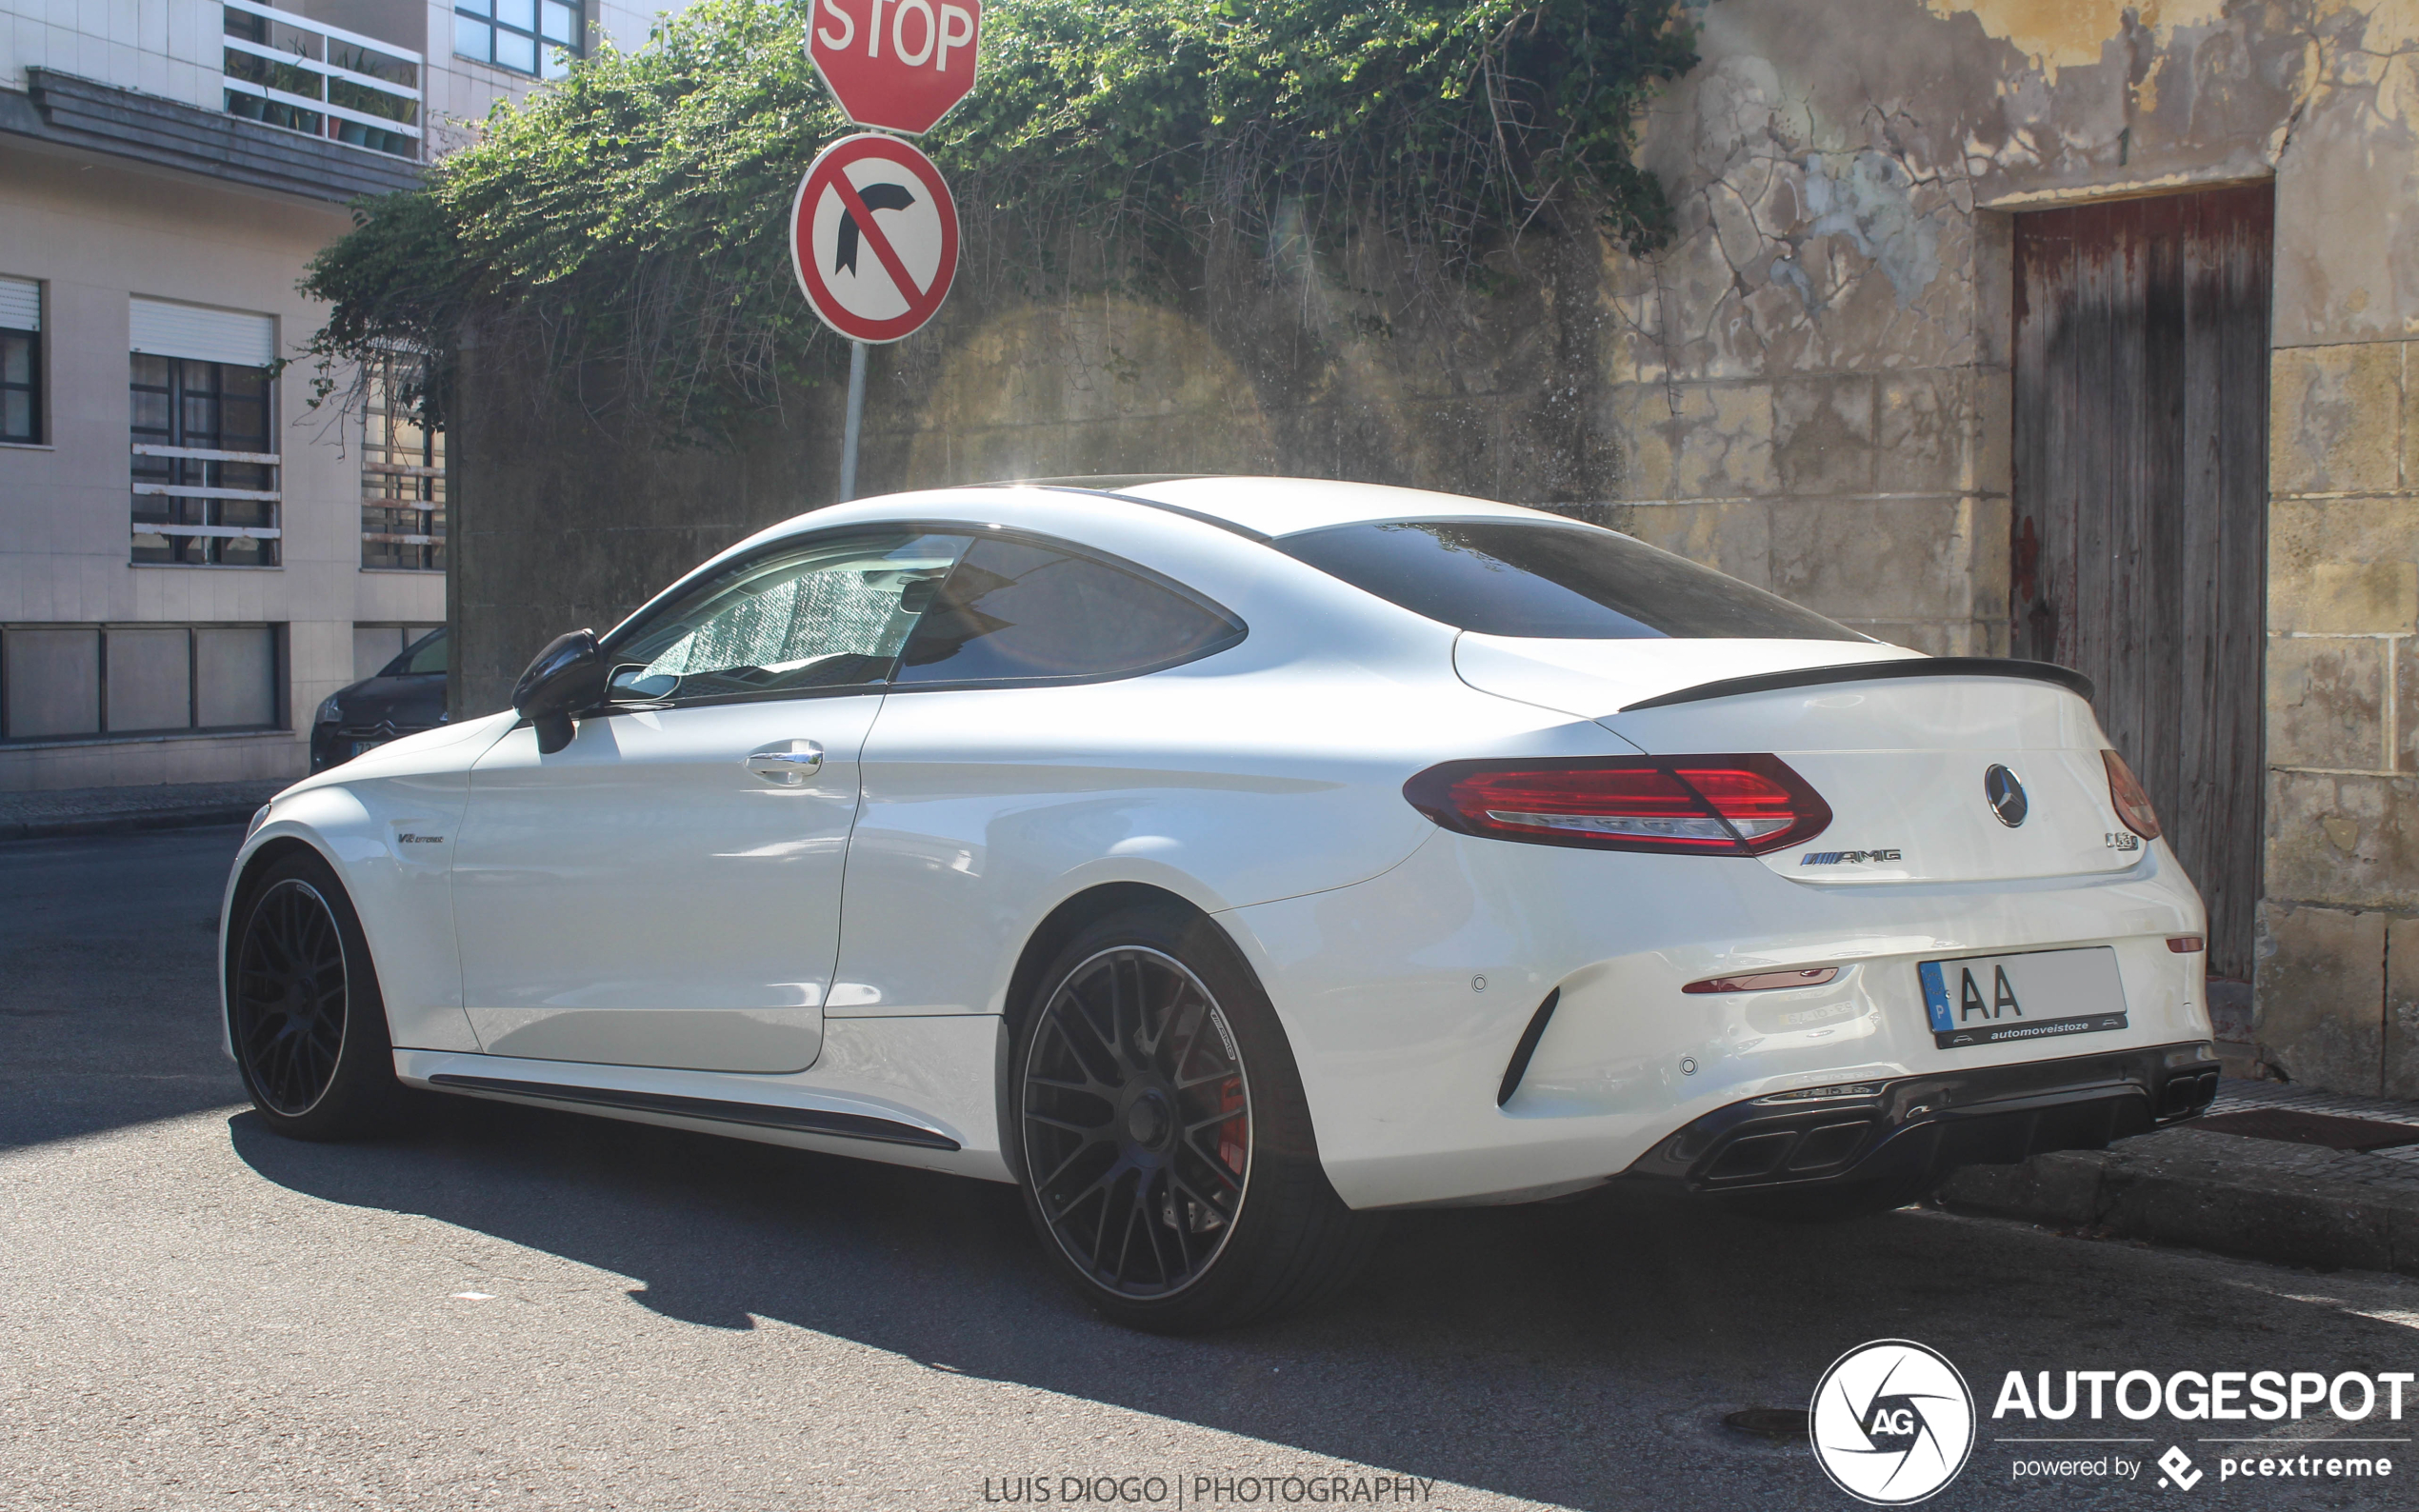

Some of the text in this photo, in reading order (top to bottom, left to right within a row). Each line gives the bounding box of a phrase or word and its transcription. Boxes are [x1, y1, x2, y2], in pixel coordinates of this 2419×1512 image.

[817, 0, 973, 71] STOP
[1935, 1005, 1945, 1019] P
[1961, 965, 2022, 1022] AA
[1990, 1023, 2089, 1040] automoveistoze
